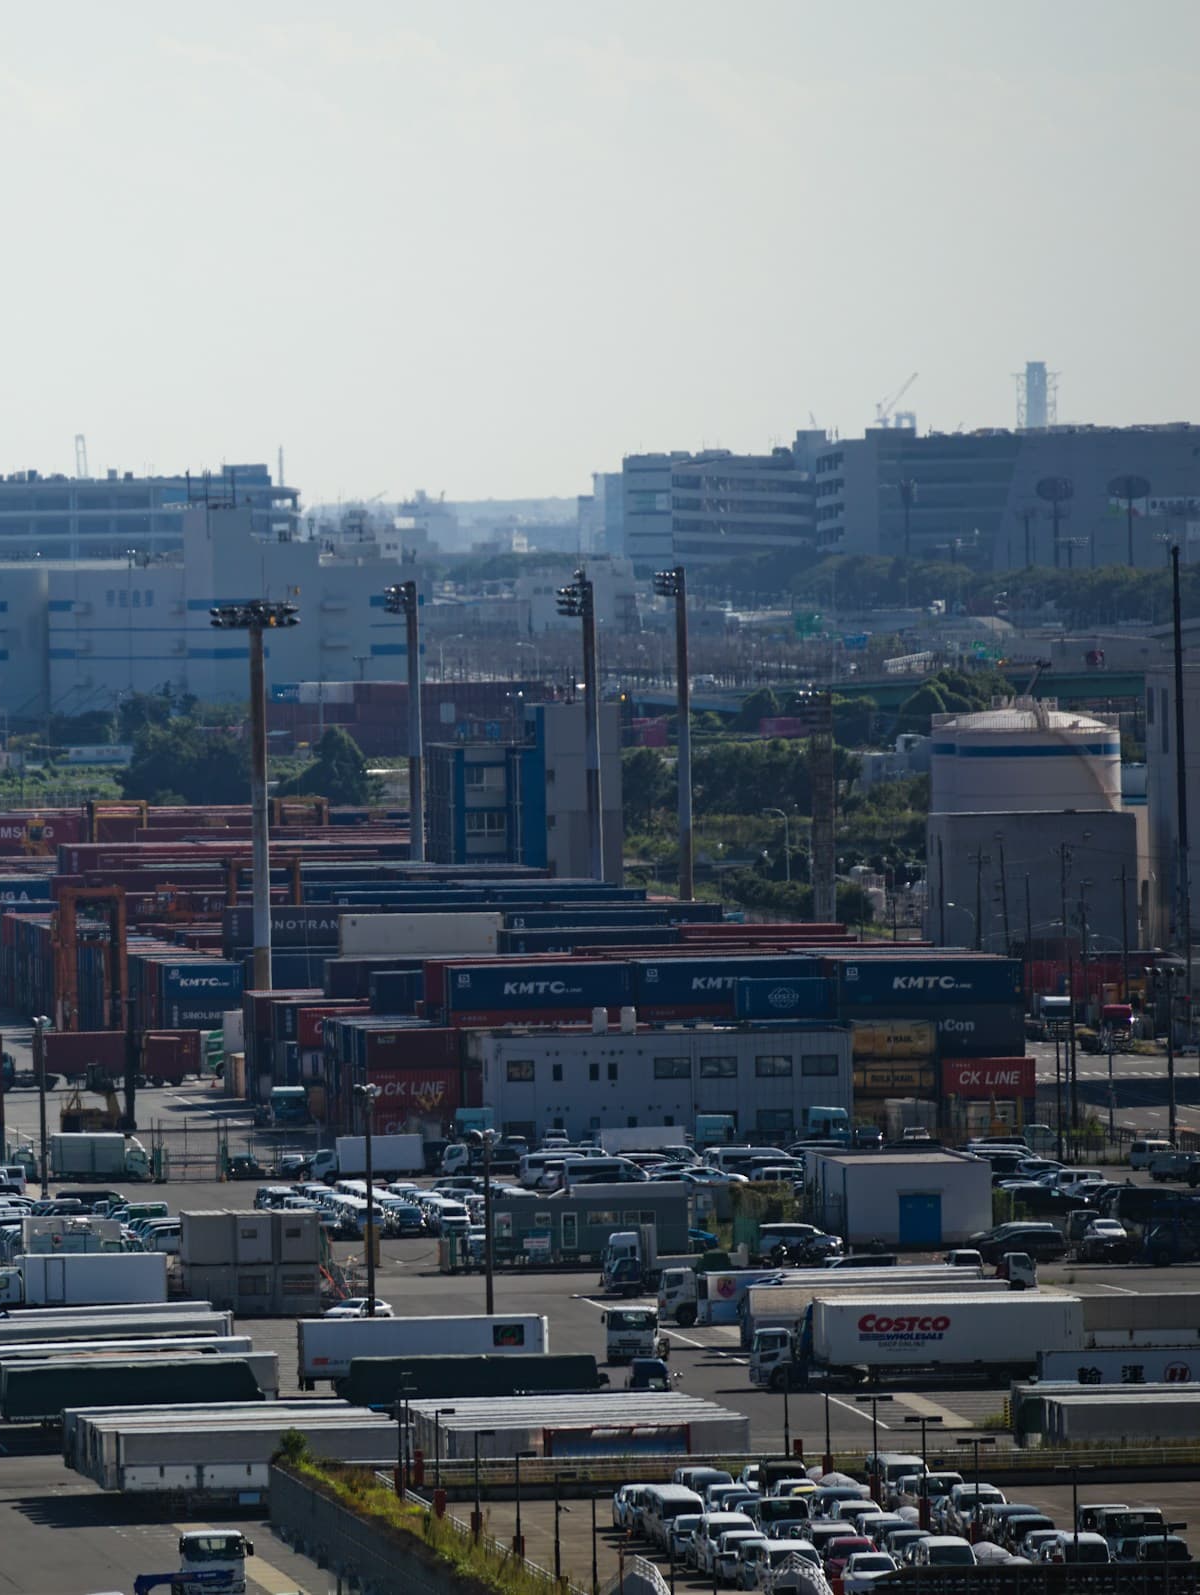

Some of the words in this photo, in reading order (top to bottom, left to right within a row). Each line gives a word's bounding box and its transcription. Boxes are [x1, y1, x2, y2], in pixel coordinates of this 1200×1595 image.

[180, 978, 219, 988] KMTC
[504, 980, 565, 995] KMTC
[692, 976, 738, 990] KMT
[892, 976, 955, 990] KMTC
[182, 1010, 225, 1020] SINOLINE
[959, 1071, 981, 1085] CK
[984, 1071, 1021, 1085] LINE
[384, 1081, 408, 1096] CK
[410, 1081, 446, 1097] LINE
[886, 1332, 945, 1341] WHOLESALE
